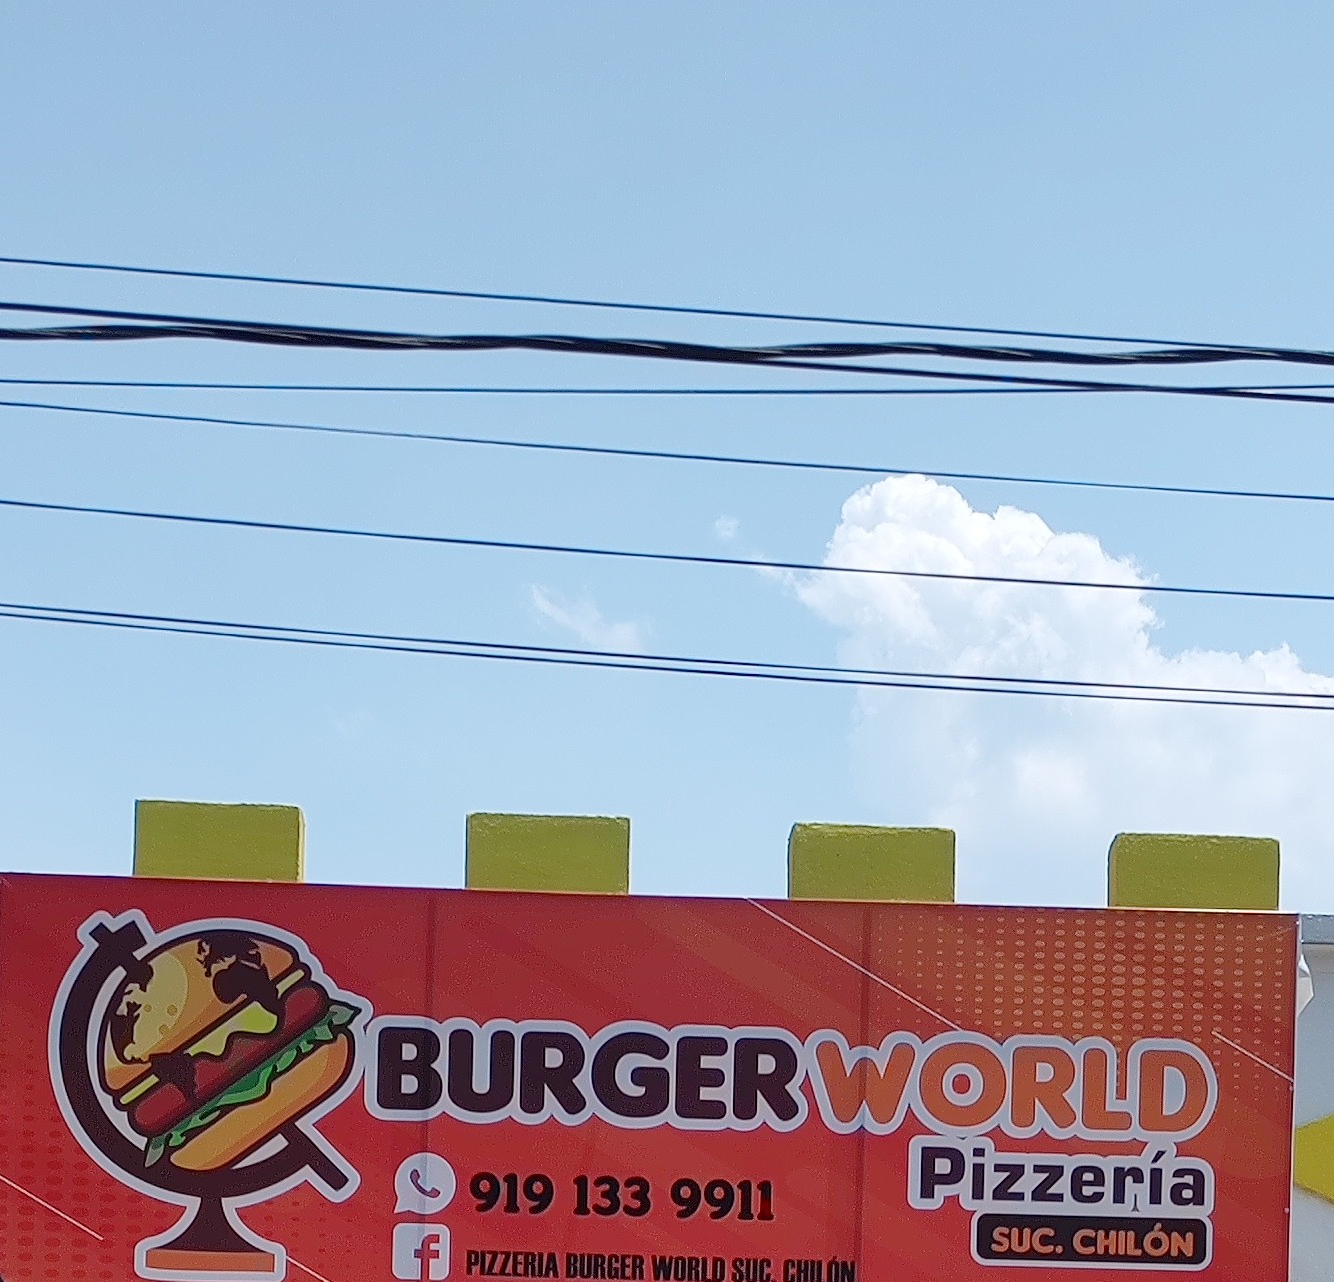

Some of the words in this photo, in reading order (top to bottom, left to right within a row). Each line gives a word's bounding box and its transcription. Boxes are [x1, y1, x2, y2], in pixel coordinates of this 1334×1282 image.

[469, 1171, 555, 1215] 919
[572, 1174, 652, 1217] 133
[669, 1177, 775, 1222] 9911
[919, 1146, 1205, 1207] Pizzería
[990, 1227, 1063, 1255] SUC.
[1078, 1222, 1194, 1258] CHILÓN
[466, 1249, 559, 1279] PIZZERIA
[566, 1253, 645, 1281] BURGER
[652, 1255, 727, 1282] WORLD
